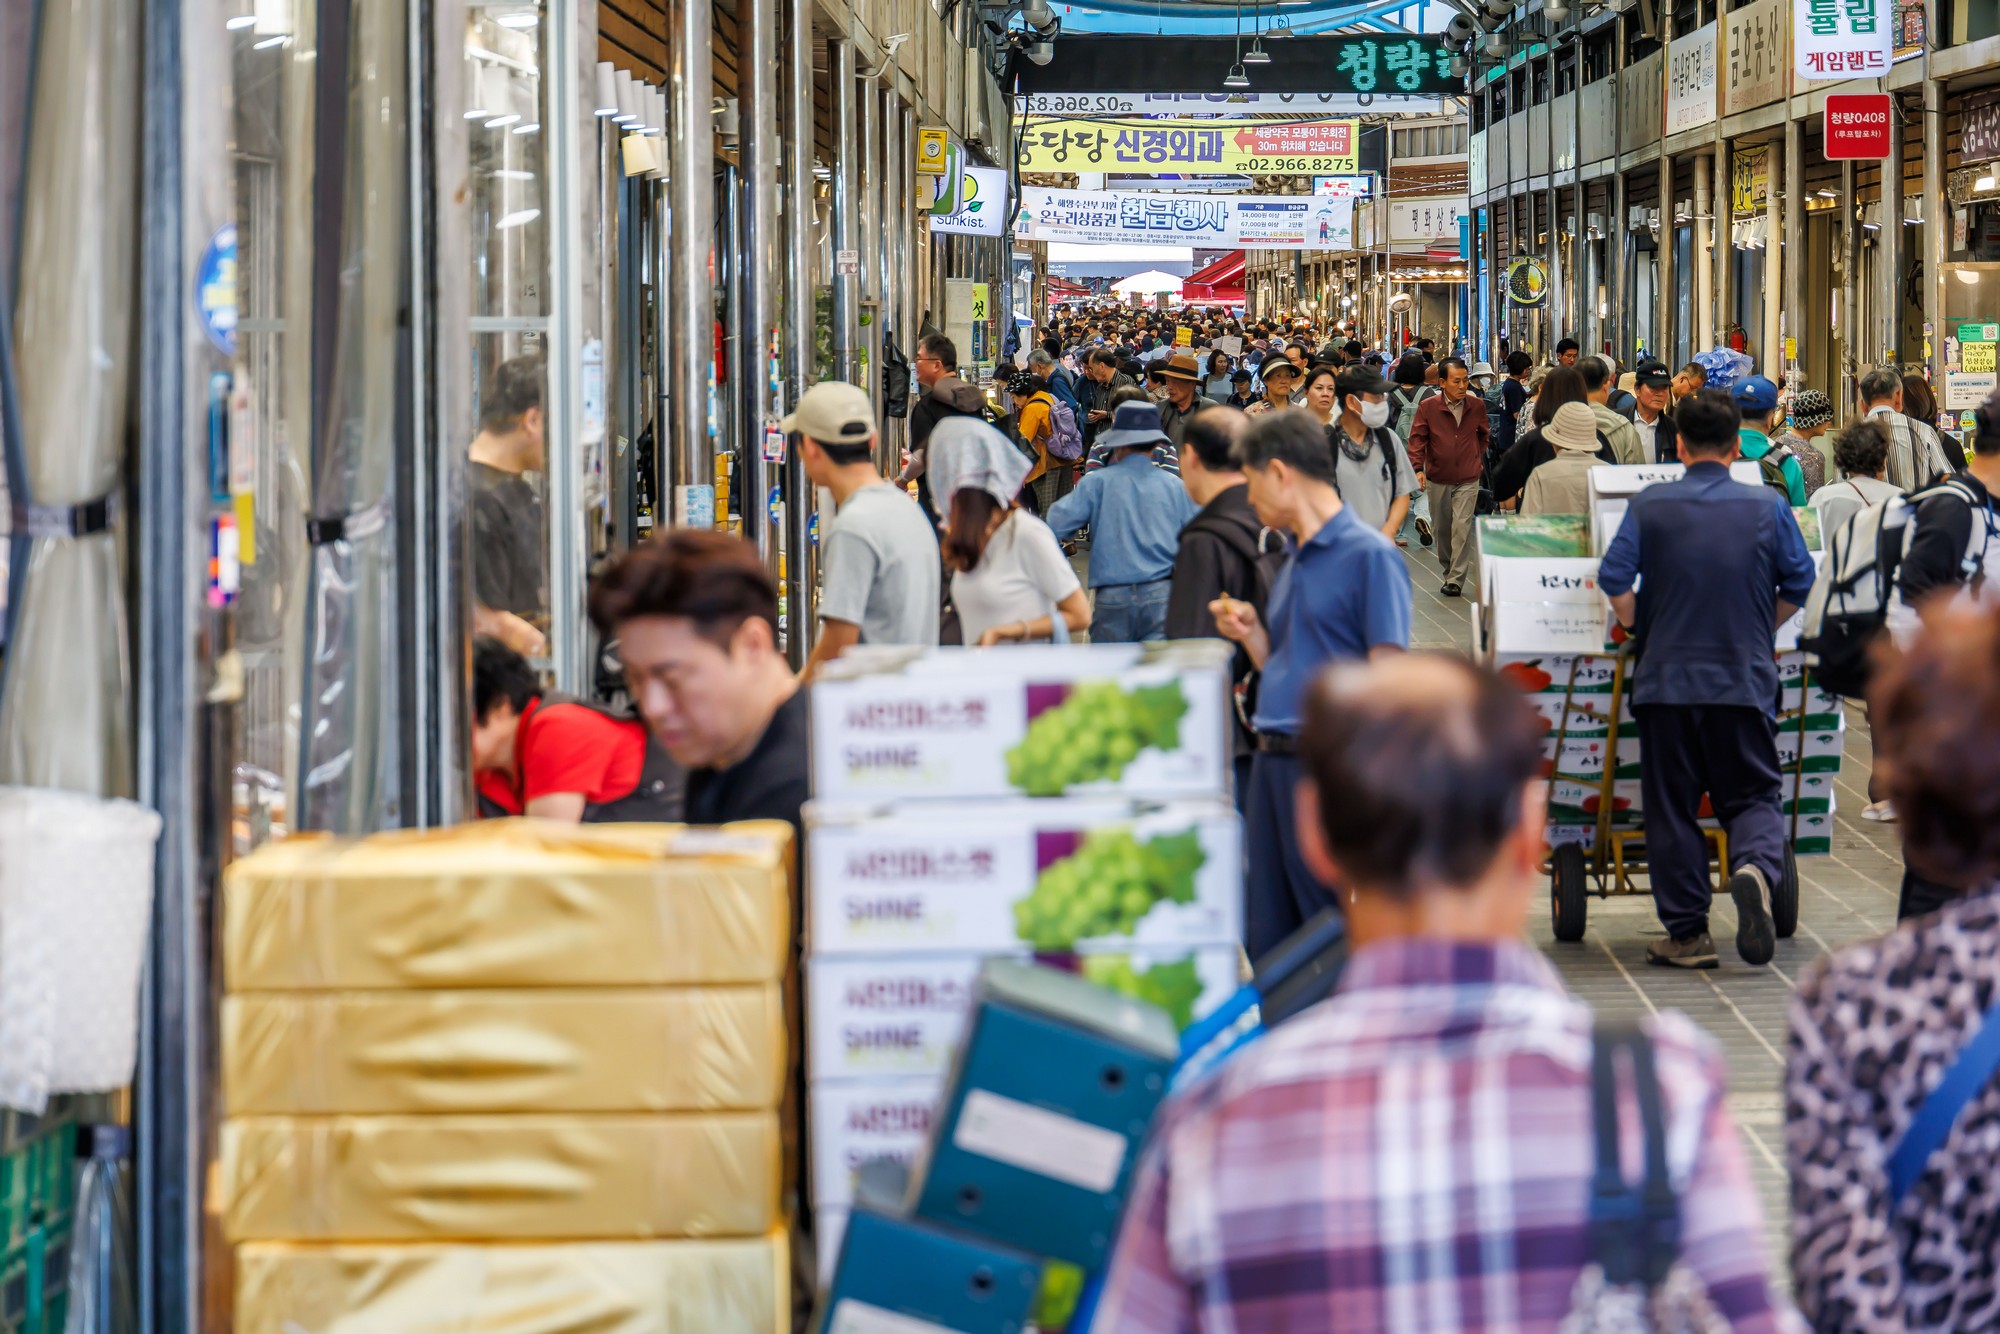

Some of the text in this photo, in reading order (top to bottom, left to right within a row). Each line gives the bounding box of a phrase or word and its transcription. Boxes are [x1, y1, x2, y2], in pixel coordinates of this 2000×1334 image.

[1731, 6, 1778, 89] 금호농산
[1805, 50, 1885, 73] 게임랜드
[1831, 112, 1886, 125] 청량0408
[1255, 127, 1347, 138] 세광약국 모퉁이 우회전
[1834, 130, 1882, 138] (루프탑포차)
[1114, 130, 1225, 163] 신경외과
[1258, 141, 1344, 152] 30m 위치해 있습니다
[1248, 159, 1354, 171] 02.966.8275
[1058, 199, 1117, 210] 해양수산부 지원
[936, 214, 984, 228] Sunkist
[1039, 209, 1117, 228] 온누리상품권
[1120, 198, 1229, 232] 환급행사
